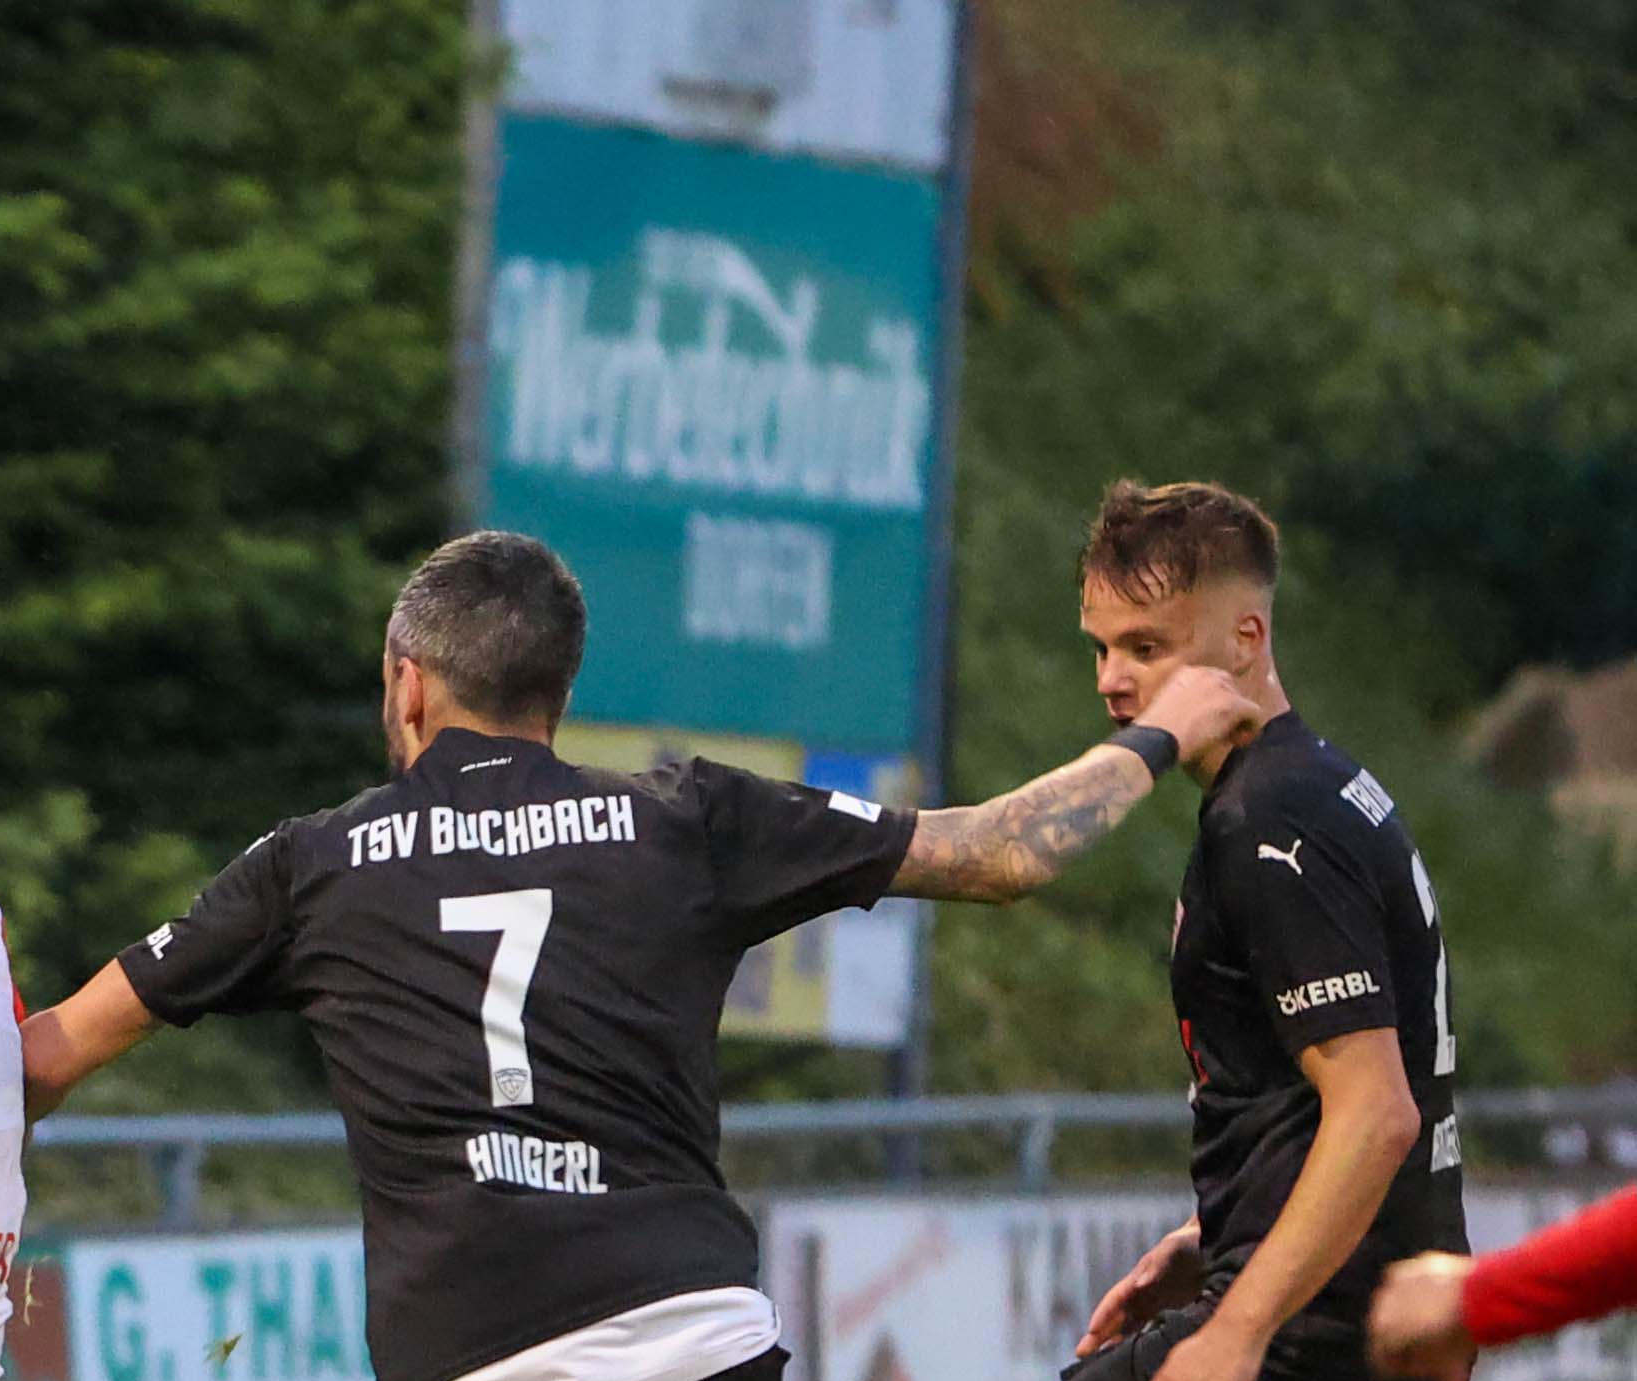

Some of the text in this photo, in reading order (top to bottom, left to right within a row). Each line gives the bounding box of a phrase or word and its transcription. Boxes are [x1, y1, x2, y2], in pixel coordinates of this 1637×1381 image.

[347, 795, 637, 868] TSV BUCHBACH
[438, 888, 553, 1108] 7
[465, 1130, 608, 1195] HINGERL
